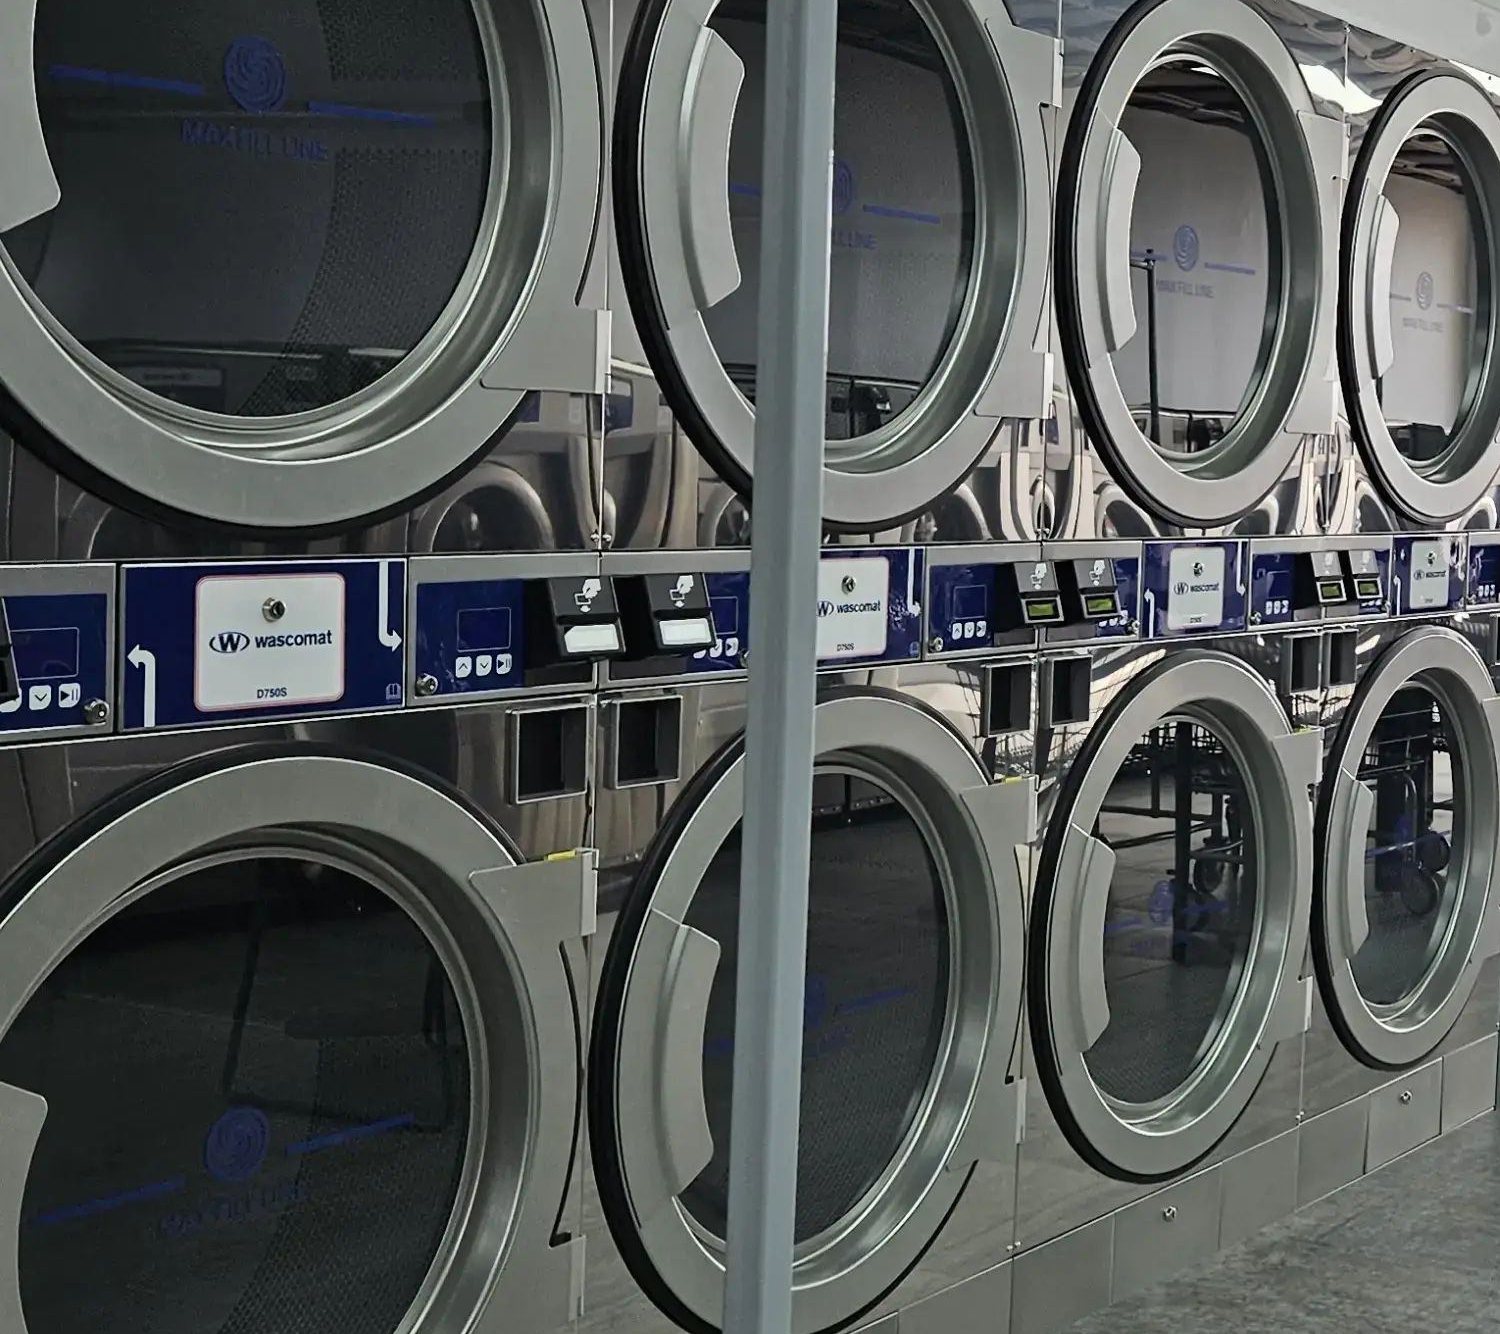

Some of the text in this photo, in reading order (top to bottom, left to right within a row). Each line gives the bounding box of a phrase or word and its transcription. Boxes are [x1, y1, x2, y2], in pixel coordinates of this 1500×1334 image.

[836, 600, 881, 614] wascomat
[255, 630, 332, 648] wascomat
[256, 687, 287, 699] D750S
